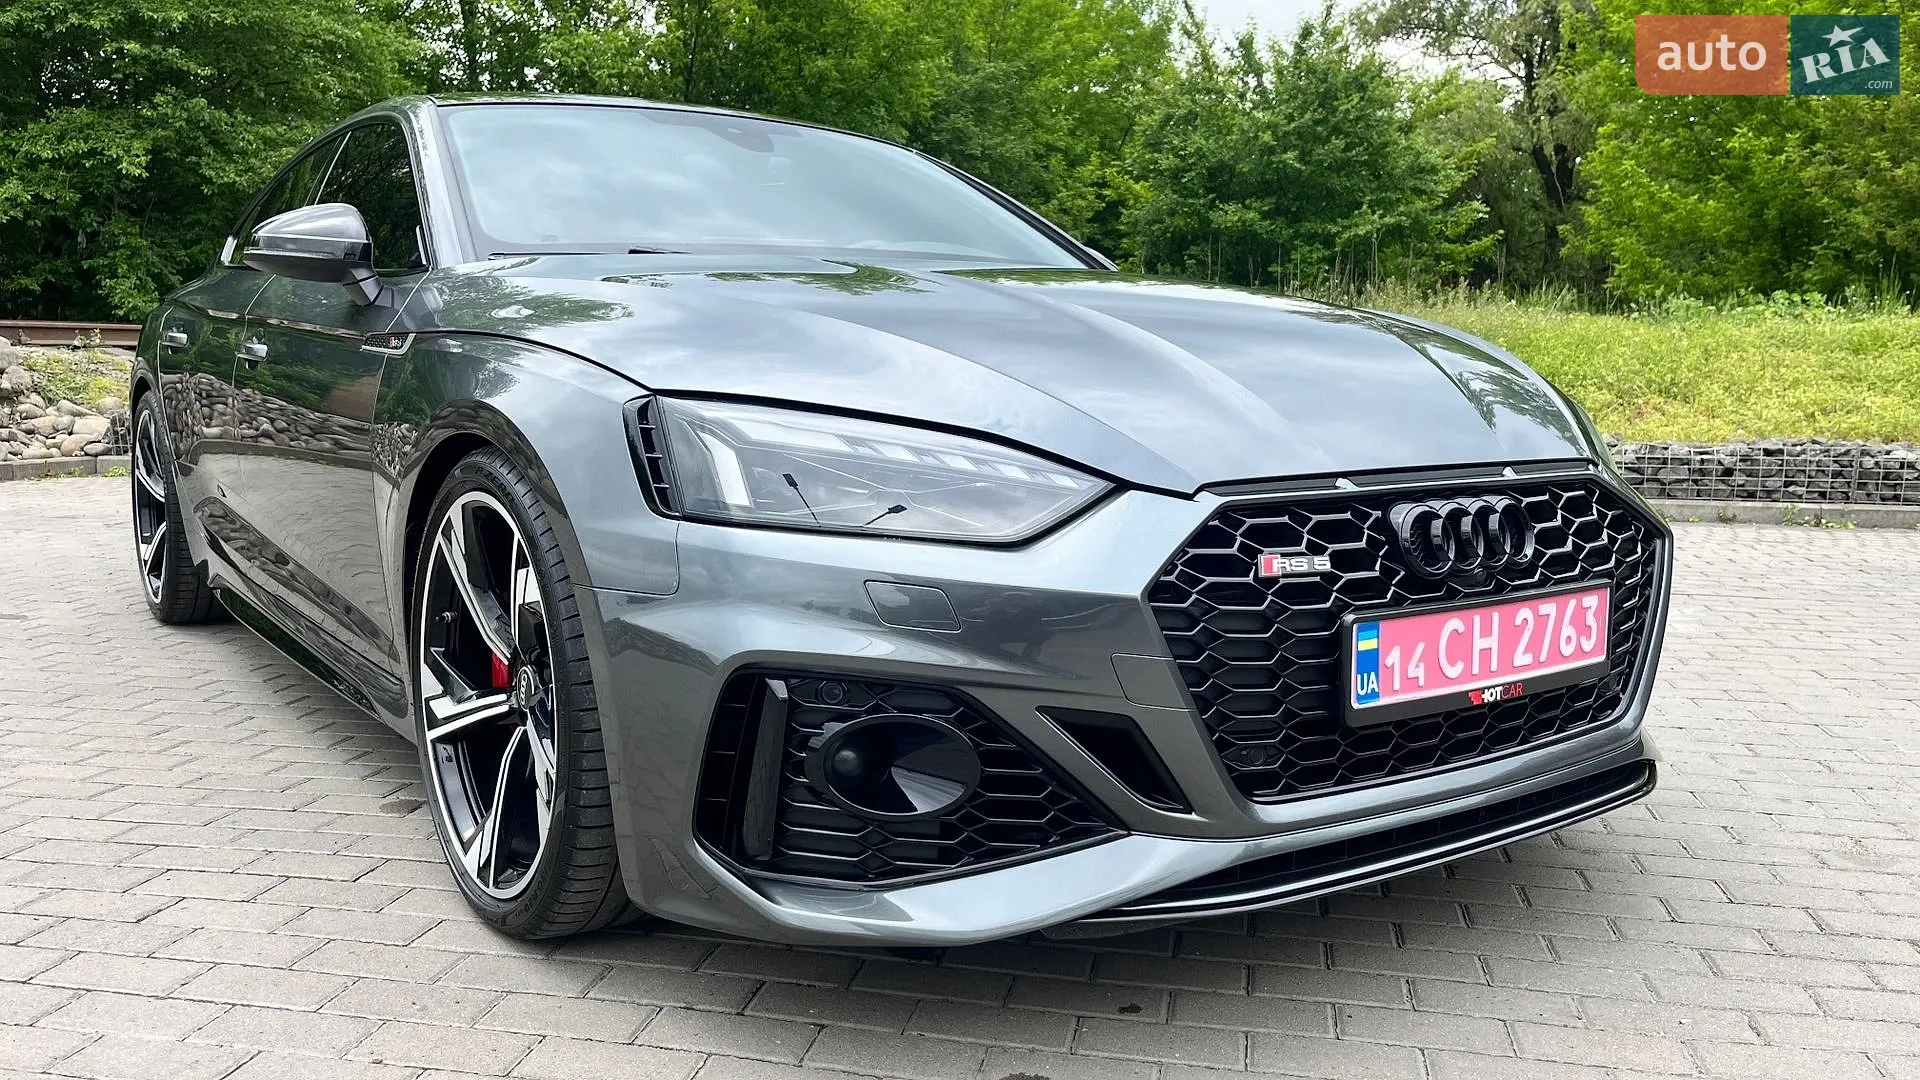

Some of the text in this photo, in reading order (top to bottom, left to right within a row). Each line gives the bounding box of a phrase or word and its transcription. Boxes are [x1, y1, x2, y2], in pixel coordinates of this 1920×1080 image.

[1272, 556, 1331, 573] RS 5
[1384, 594, 1599, 692] 14 CH 2763
[1356, 671, 1379, 696] UA
